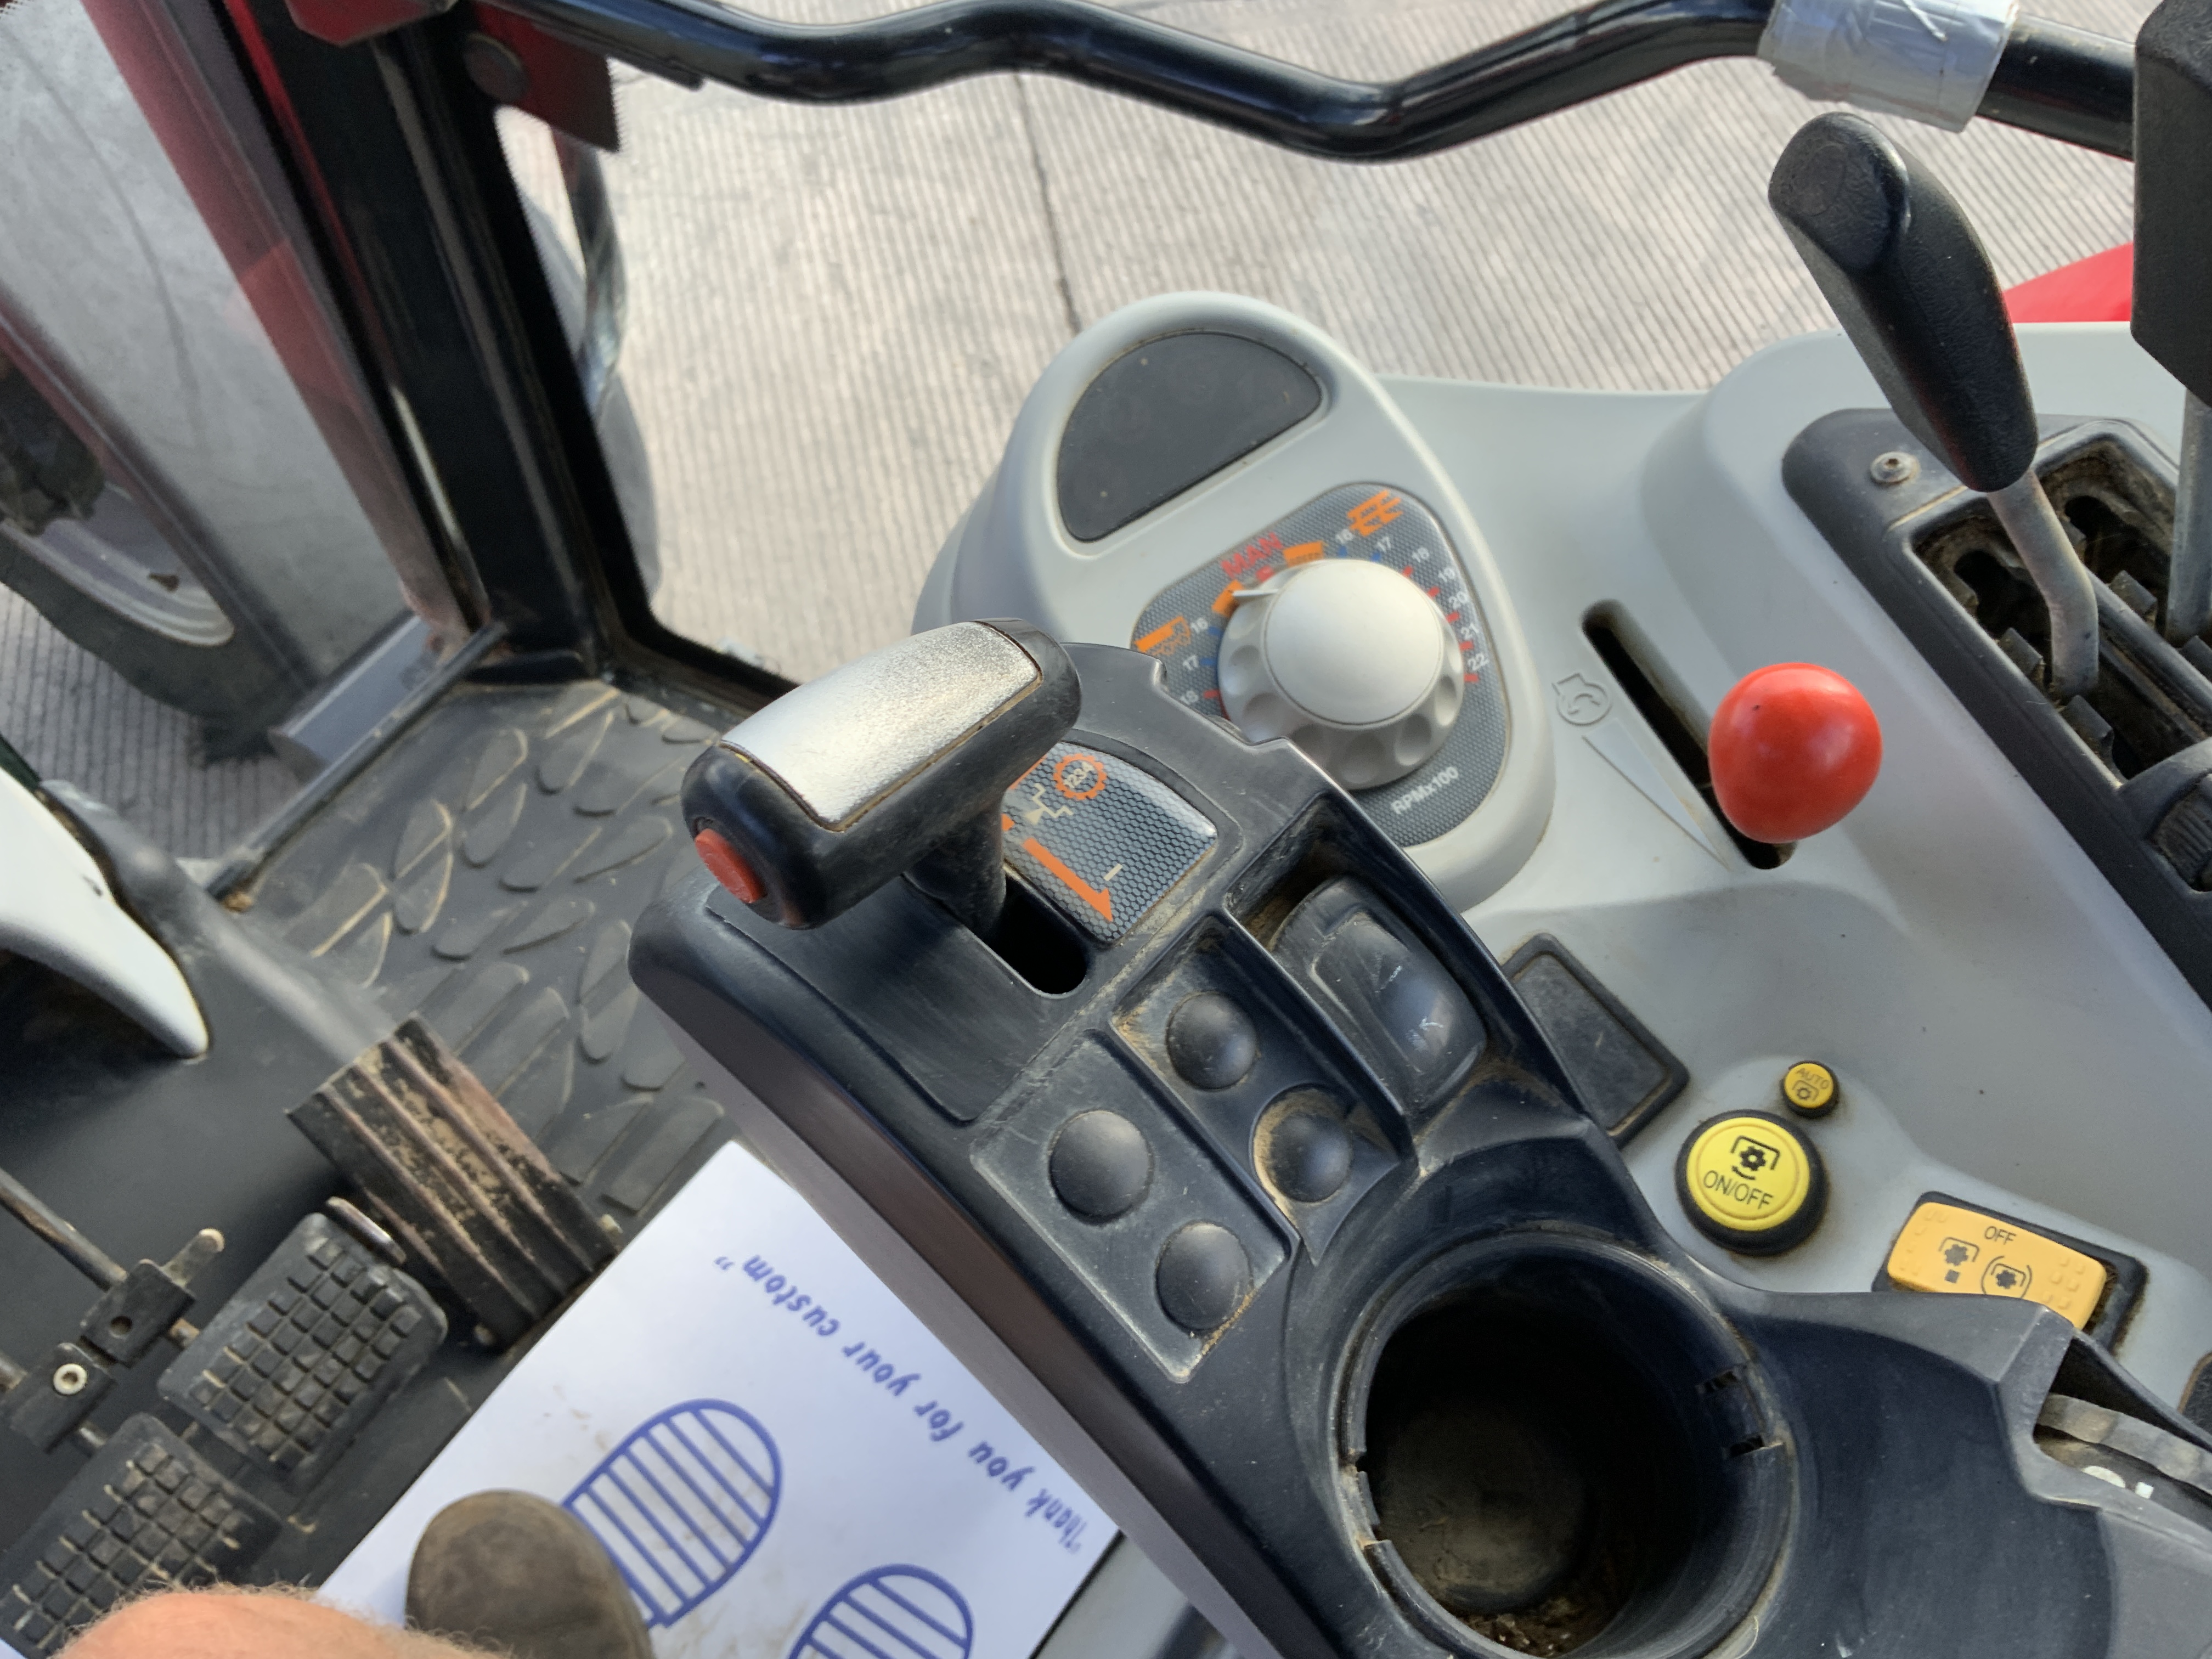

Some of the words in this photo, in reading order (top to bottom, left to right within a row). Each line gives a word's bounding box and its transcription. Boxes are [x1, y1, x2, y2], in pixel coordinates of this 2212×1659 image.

[1376, 536, 1392, 553] 17
[1220, 531, 1283, 580] MAN
[1412, 547, 1430, 563] 18
[1438, 567, 1455, 583] 19
[1448, 590, 1469, 610] 20
[1190, 617, 1209, 634] 16
[1460, 622, 1479, 640] 21
[1182, 654, 1199, 671] 17
[1468, 653, 1490, 672] 22
[1796, 1067, 1830, 1090] AUTO
[1702, 1169, 1774, 1210] ON/OFF
[1984, 1226, 2017, 1245] OFF
[841, 1341, 922, 1397] your
[913, 1400, 964, 1442] for
[967, 1440, 1036, 1492] you
